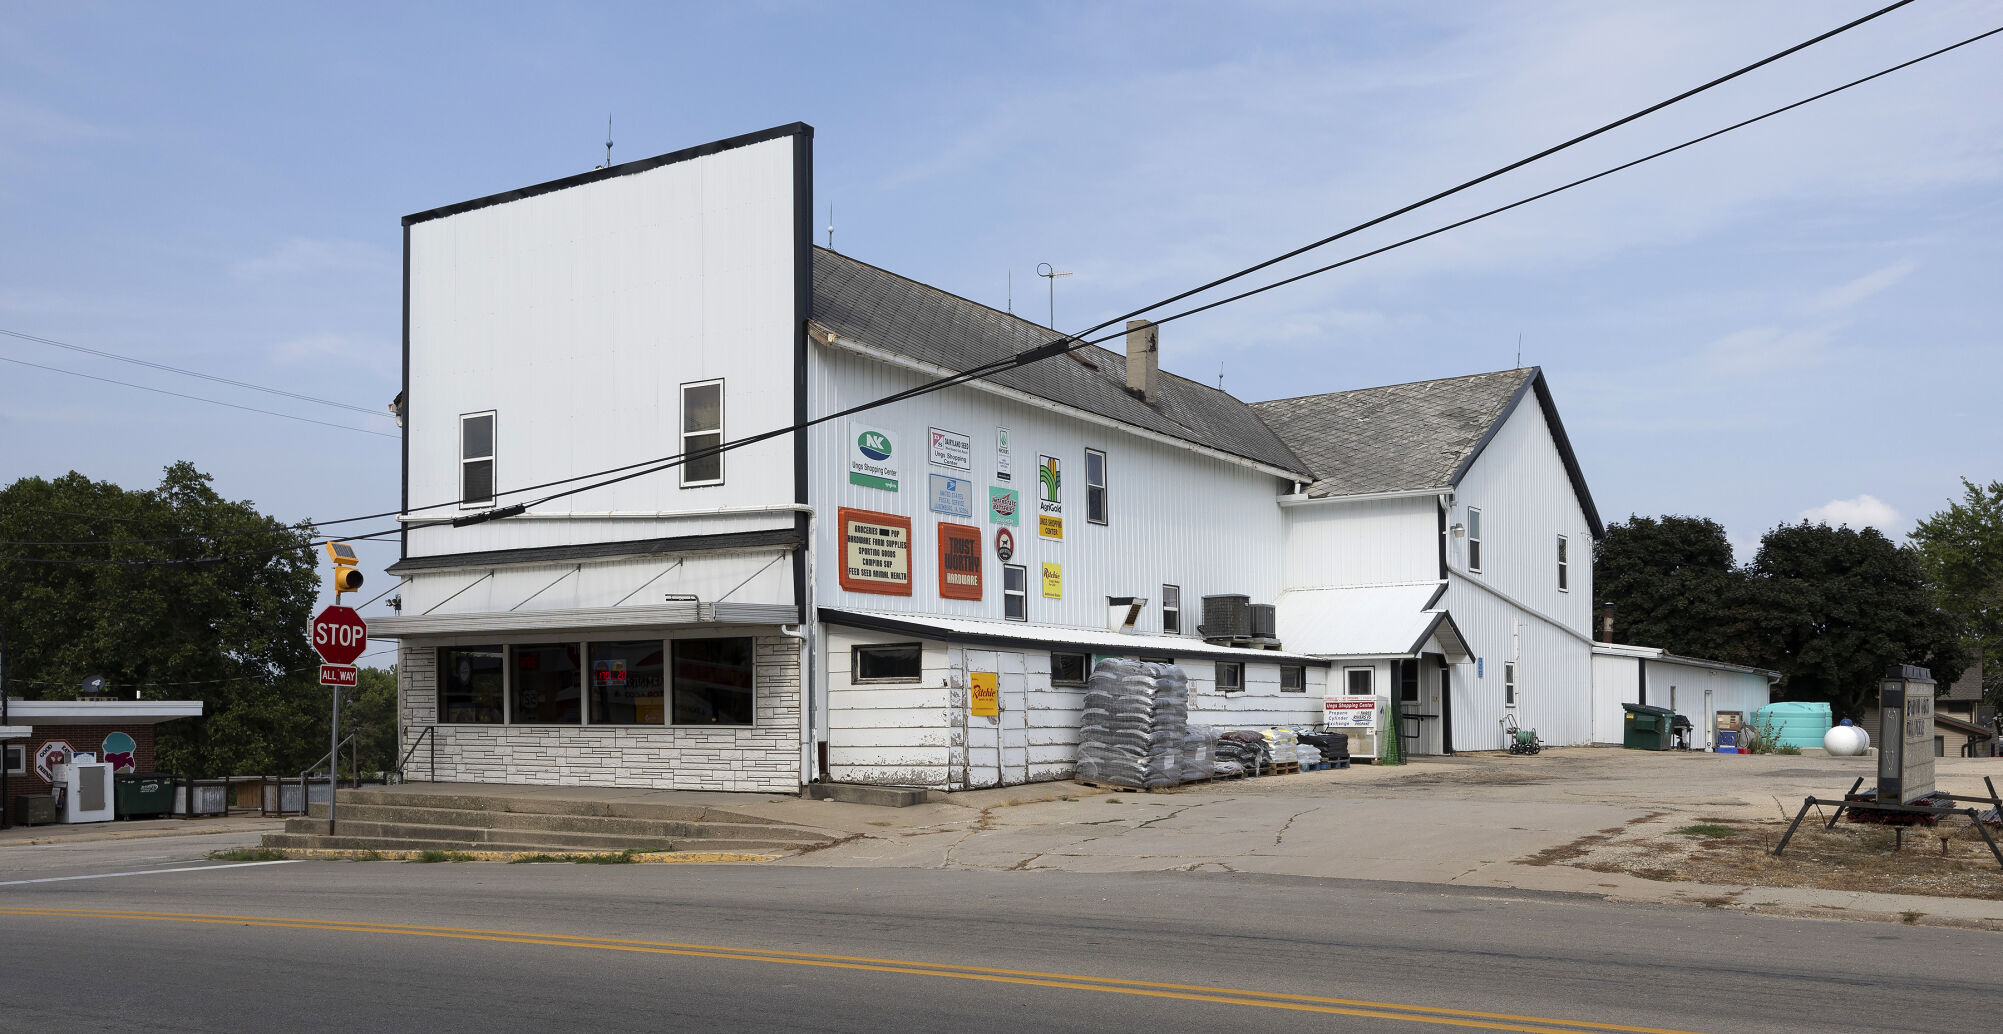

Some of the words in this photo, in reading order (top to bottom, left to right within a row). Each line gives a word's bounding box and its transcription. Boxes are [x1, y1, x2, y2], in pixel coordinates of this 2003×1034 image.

[866, 433, 885, 450] NK
[934, 450, 946, 459] Ungs
[946, 452, 967, 463] Shopping
[943, 458, 958, 466] Center
[852, 460, 864, 471] Ungs
[864, 462, 883, 475] Shopping
[884, 467, 897, 476] Center
[1040, 501, 1062, 514] AgriGold
[854, 525, 878, 536] GROCERIES
[891, 529, 900, 538] POP
[1045, 527, 1058, 536] CENTER
[847, 534, 871, 545] HARDWARE
[872, 538, 885, 546] FARM
[886, 540, 907, 549] SUPPLIES
[949, 537, 975, 555] TRUST
[859, 547, 880, 557] SPORTING
[881, 549, 896, 558] GOODS
[862, 558, 882, 567] CAMPING
[884, 560, 893, 568] SUP
[945, 553, 980, 572] WORTHY
[848, 567, 860, 576] FEED
[861, 568, 872, 577] SEED
[873, 570, 890, 579] ANIMAL
[891, 572, 907, 580] HEALTH
[946, 573, 978, 586] HARDWARE
[1043, 567, 1061, 579] Ritchie
[316, 622, 364, 647] STOP
[322, 670, 336, 680] ALL
[340, 671, 355, 681] WAY
[972, 684, 996, 699] Ritchie
[39, 743, 53, 758] GOOD
